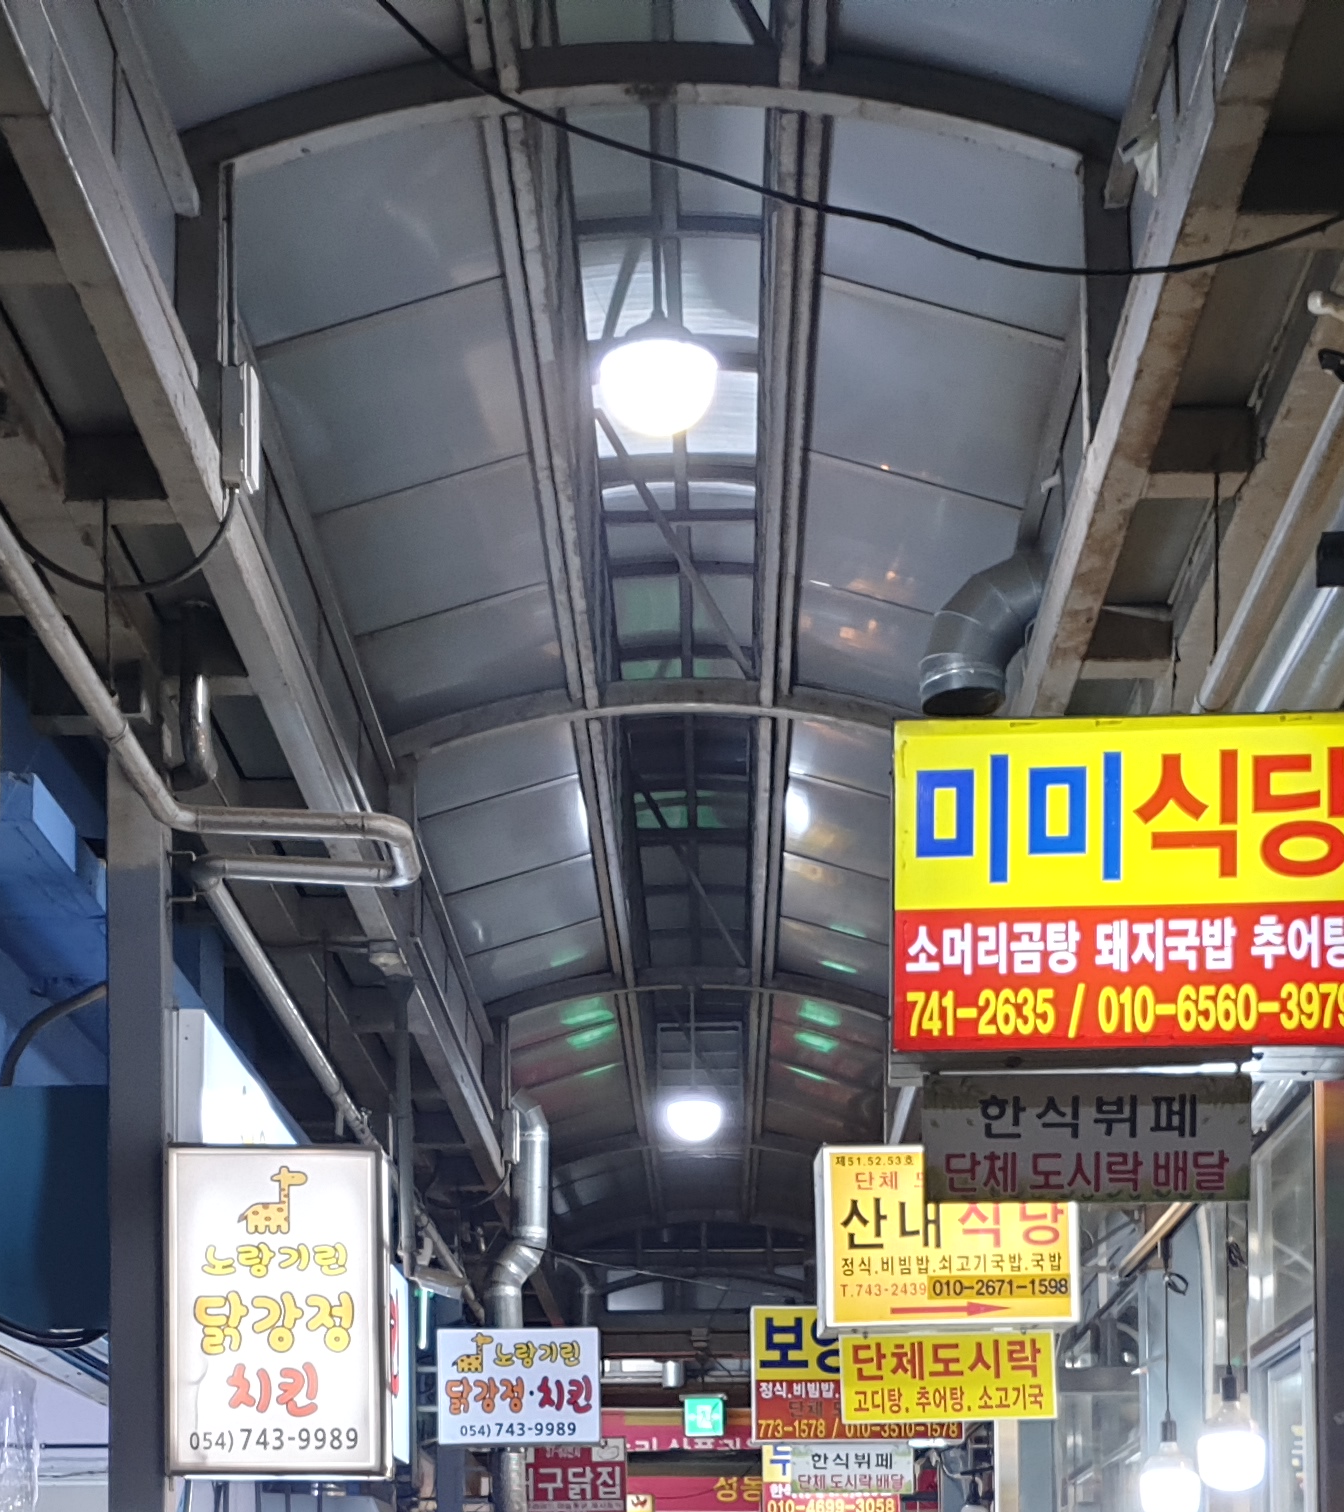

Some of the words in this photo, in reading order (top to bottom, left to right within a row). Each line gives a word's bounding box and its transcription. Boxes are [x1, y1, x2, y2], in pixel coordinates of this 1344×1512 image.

[905, 918, 1080, 976] 소머리곰탕
[1095, 915, 1238, 972] 돼지국밥
[906, 987, 1055, 1038] 741-2635
[979, 1094, 1199, 1140] 한식뷔페
[854, 1170, 899, 1191] 단체
[944, 1151, 1018, 1195] 단체
[1029, 1150, 1144, 1195] 도시락
[1152, 1149, 1230, 1195] 배달
[201, 1241, 348, 1279] 노랑기린
[932, 1277, 1069, 1298] 010-2671-1598
[193, 1290, 355, 1356] 닭강정
[493, 1340, 581, 1368] 노랑기린
[851, 1338, 1041, 1383] 단체도시락
[226, 1361, 319, 1418] 치킨
[977, 1383, 1044, 1412] 소고기국
[758, 1419, 826, 1438] 773-1578
[811, 1452, 894, 1470] 한식뷔페
[797, 1474, 826, 1491] 단체
[830, 1473, 872, 1490] 도시락
[875, 1473, 905, 1491] 배달
